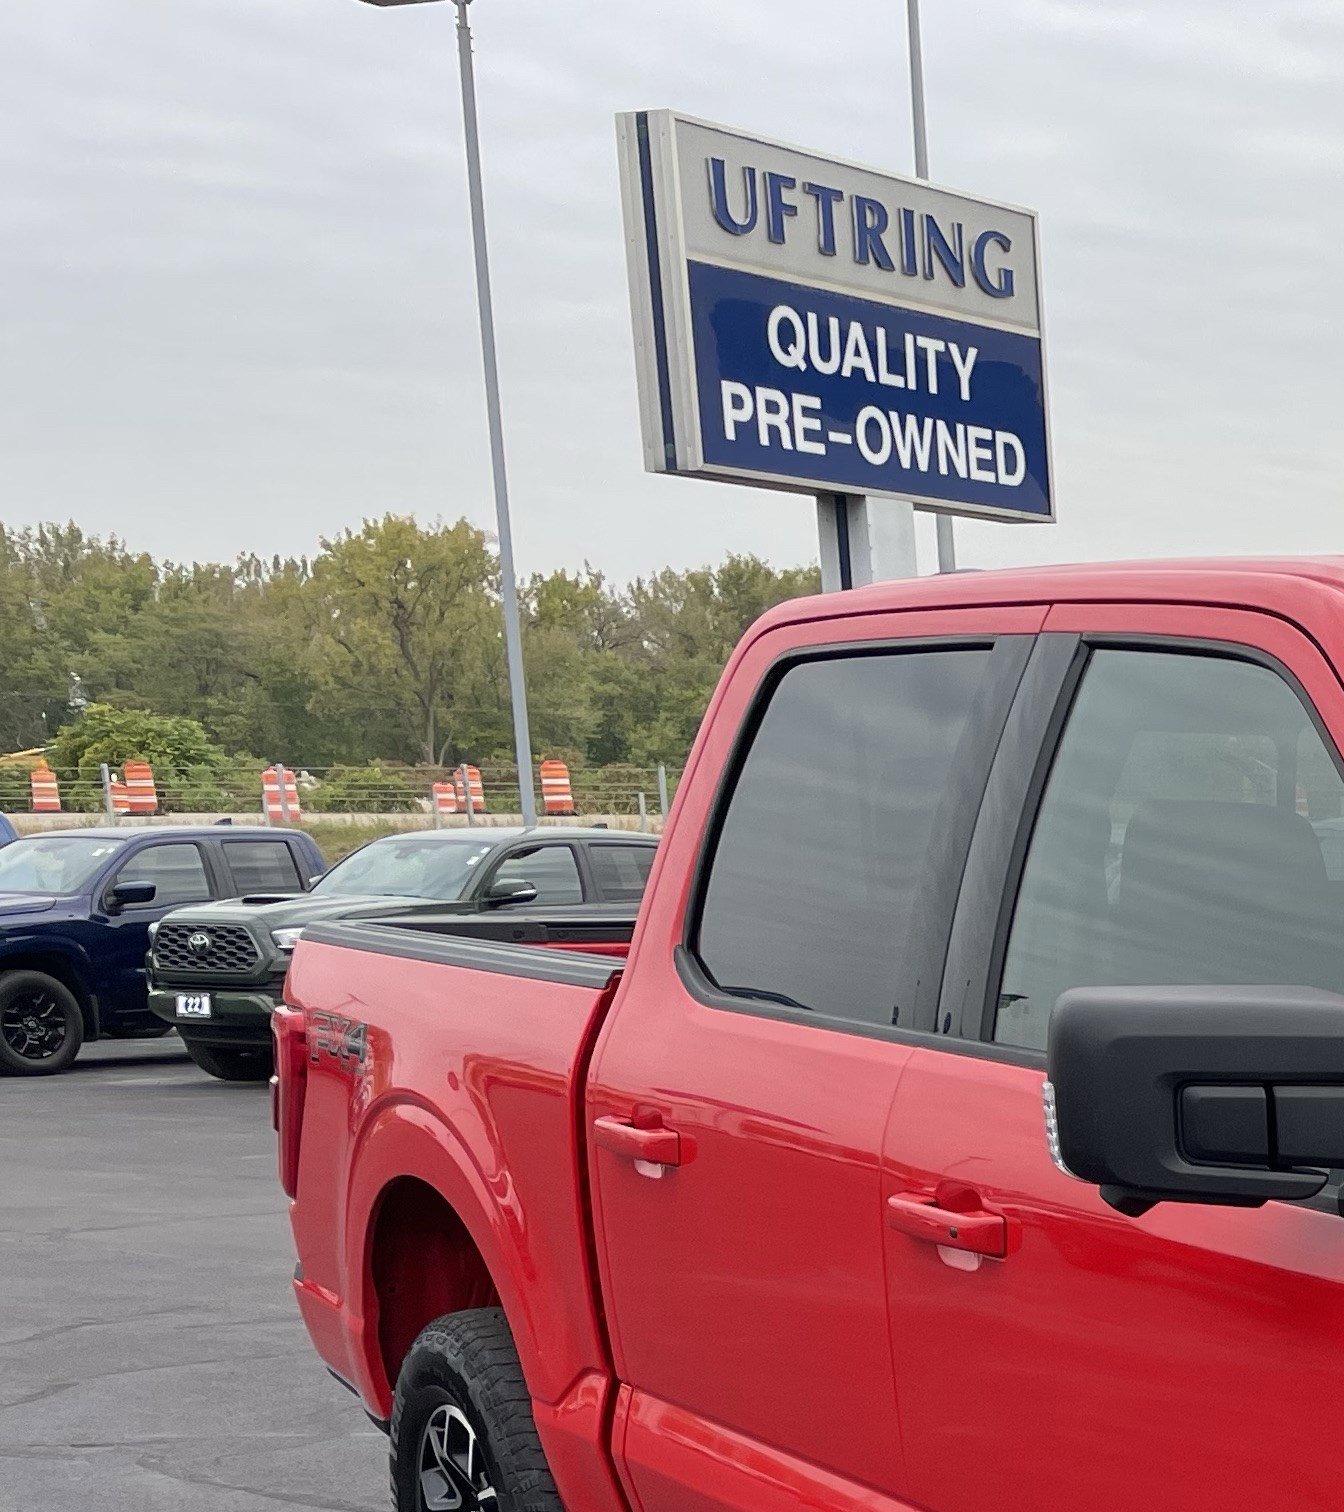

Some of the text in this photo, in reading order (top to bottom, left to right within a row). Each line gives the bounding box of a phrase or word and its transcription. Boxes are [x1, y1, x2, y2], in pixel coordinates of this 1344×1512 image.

[706, 156, 1015, 298] UFTRING
[767, 305, 978, 401] QUALITY
[720, 380, 1026, 486] PRE-OWNED
[308, 1009, 368, 1063] FX4
